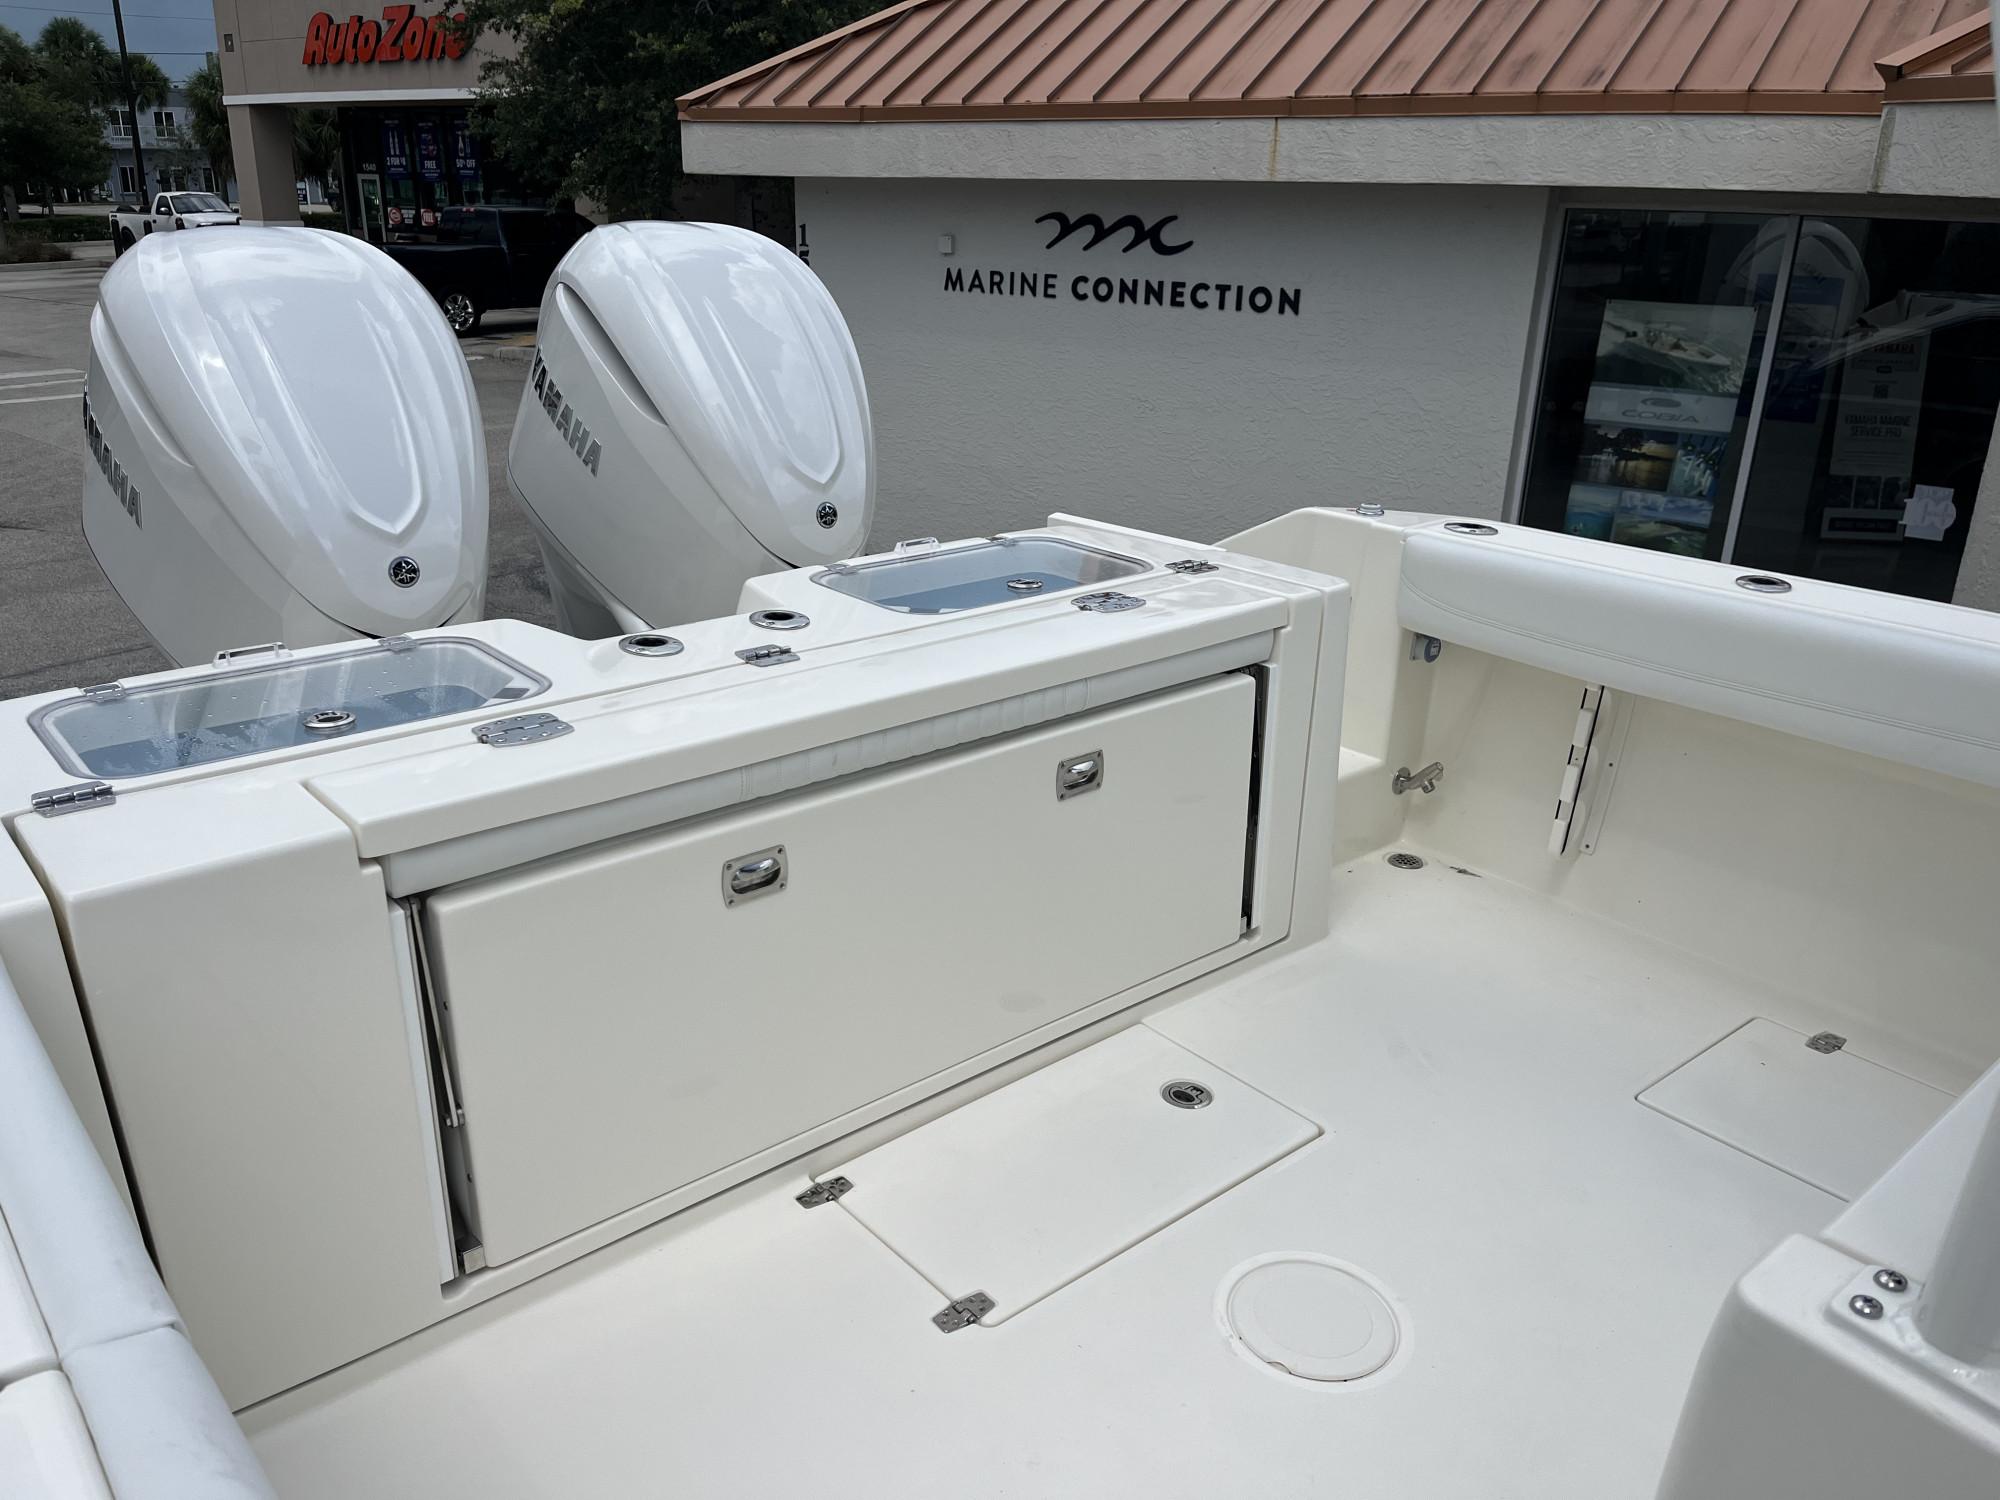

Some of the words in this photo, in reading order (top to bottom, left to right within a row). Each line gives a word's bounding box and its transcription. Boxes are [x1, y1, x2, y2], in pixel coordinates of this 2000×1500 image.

[302, 5, 466, 64] AutoZone
[424, 160, 437, 169] FREE
[466, 160, 476, 168] OFF
[944, 268, 1058, 299] MARINE
[1071, 275, 1301, 316] CONNECTION
[1621, 408, 1699, 424] COBIA
